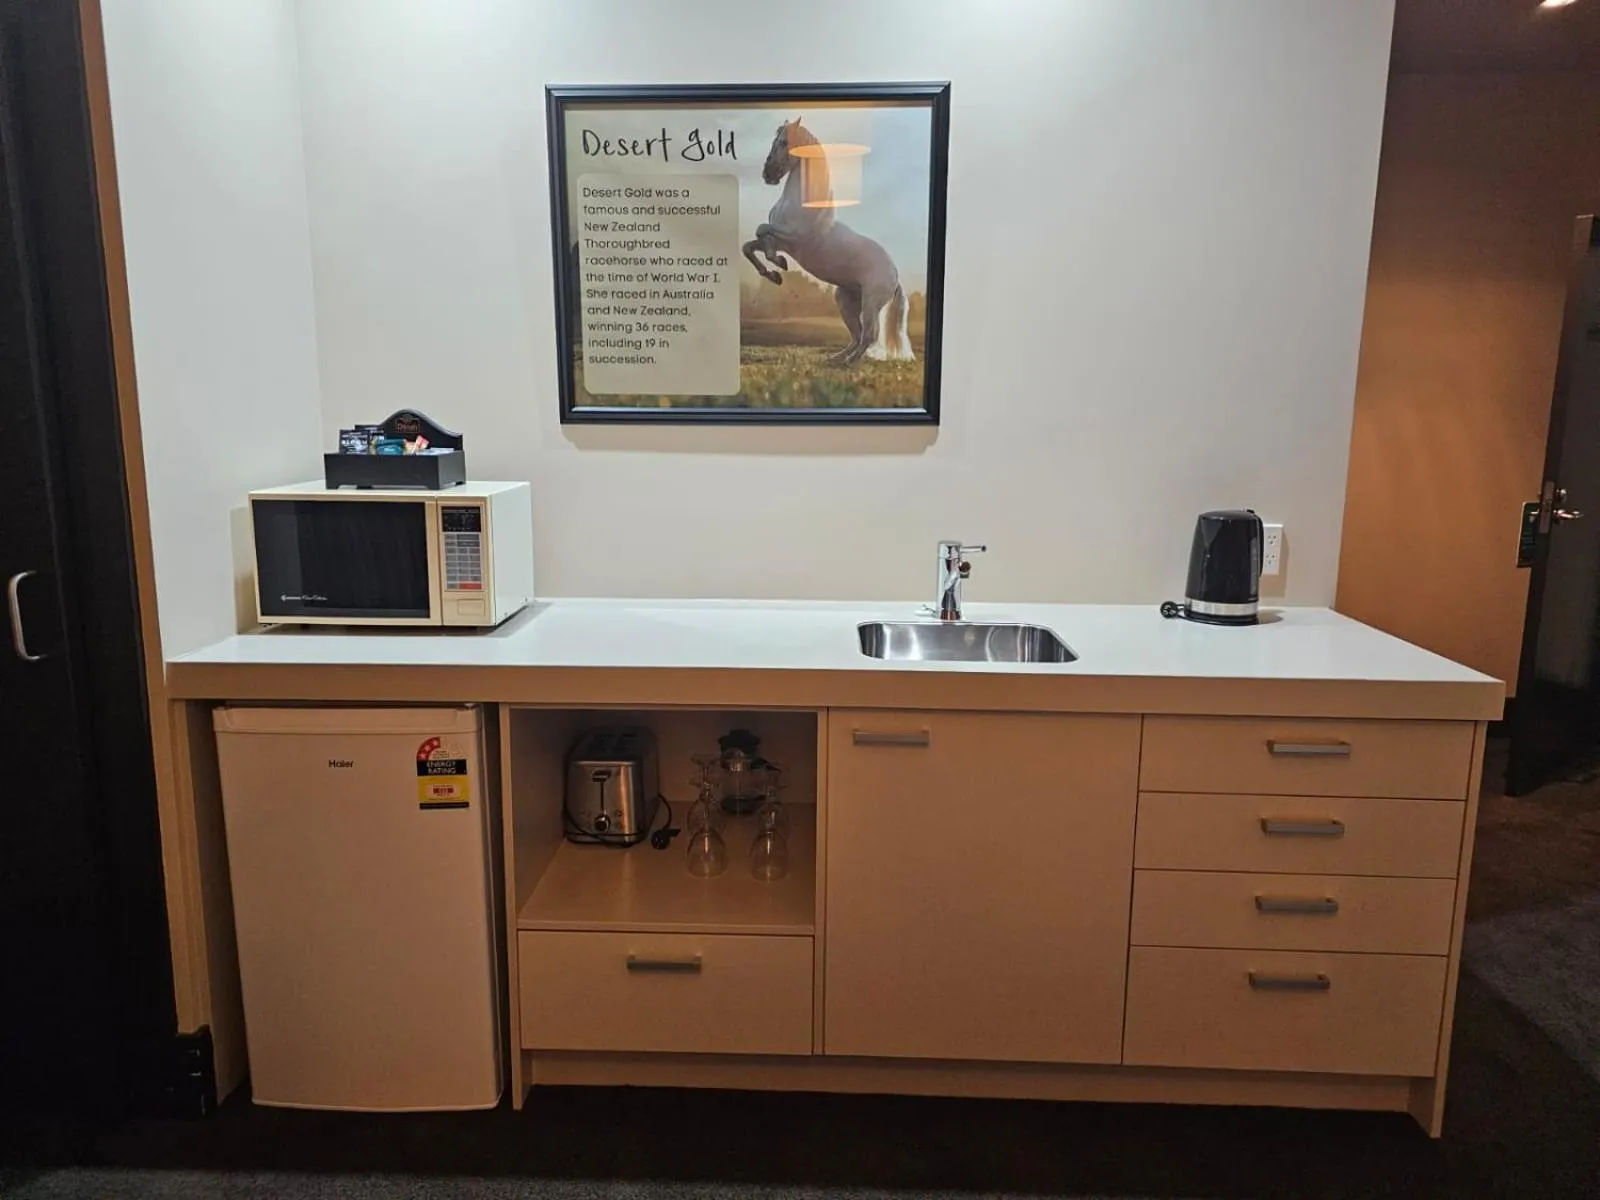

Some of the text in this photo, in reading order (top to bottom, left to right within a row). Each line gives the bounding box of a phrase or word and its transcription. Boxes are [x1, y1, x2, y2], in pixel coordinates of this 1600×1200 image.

[582, 127, 672, 162] Desert
[583, 187, 690, 198] Desert Gold was a
[583, 205, 721, 215] famous and successful
[584, 222, 660, 232] New Zealand
[585, 238, 670, 251] Thoroughbred
[585, 256, 728, 267] racehorse who raced at
[586, 273, 604, 283] the
[608, 273, 633, 283] time
[636, 273, 648, 283] of
[651, 273, 684, 283] World
[687, 273, 709, 283] War
[586, 289, 714, 300] She raced in Australia
[587, 306, 691, 317] and New Zealand,
[588, 322, 688, 334] winning 36 races,
[588, 338, 669, 350] including 19 in
[589, 355, 657, 365] succession.
[328, 759, 354, 768] Haier
